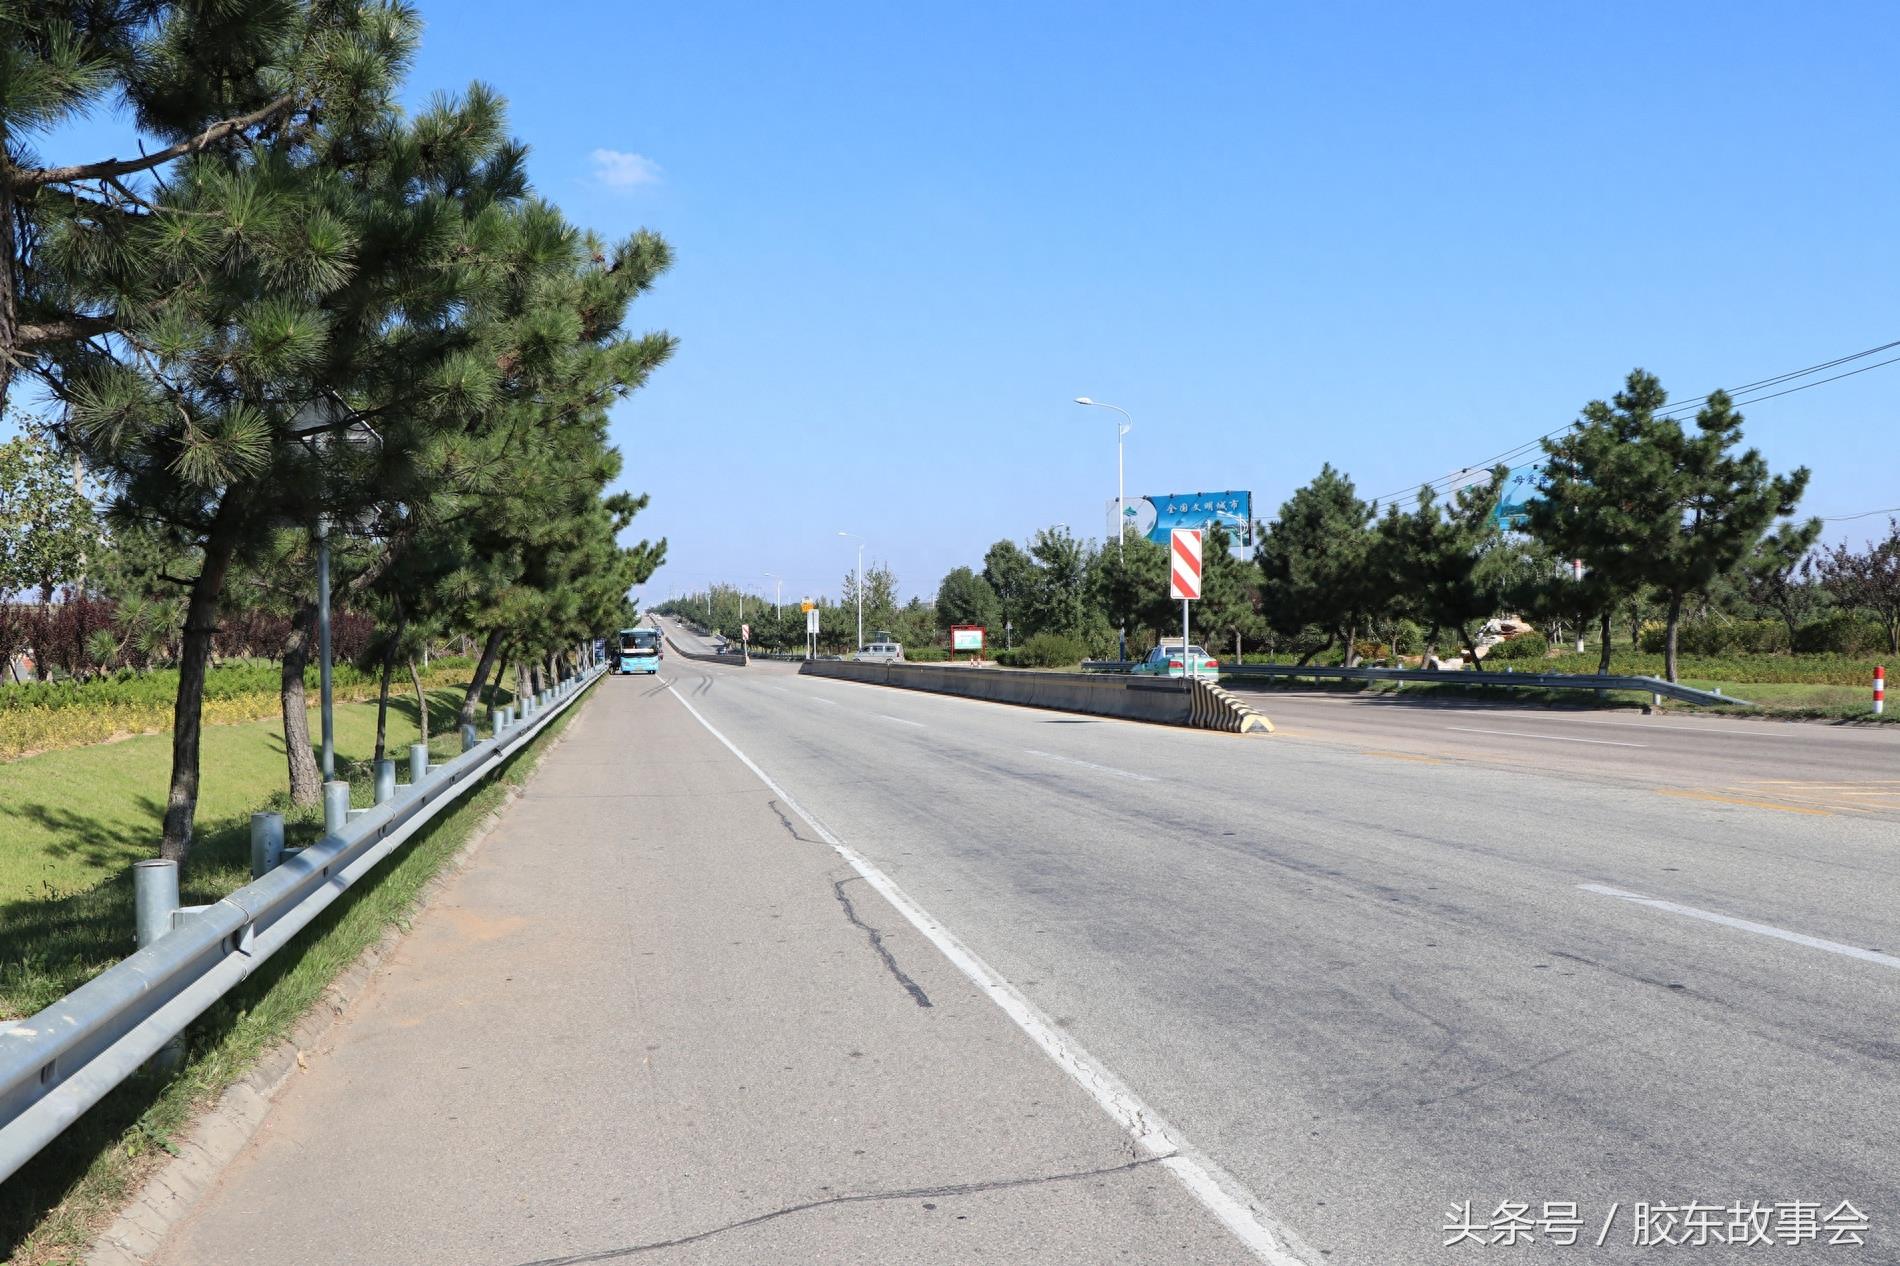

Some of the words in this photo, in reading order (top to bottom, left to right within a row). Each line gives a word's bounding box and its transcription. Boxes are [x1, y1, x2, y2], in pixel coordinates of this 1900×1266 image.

[1166, 499, 1239, 514] 全国文明城市
